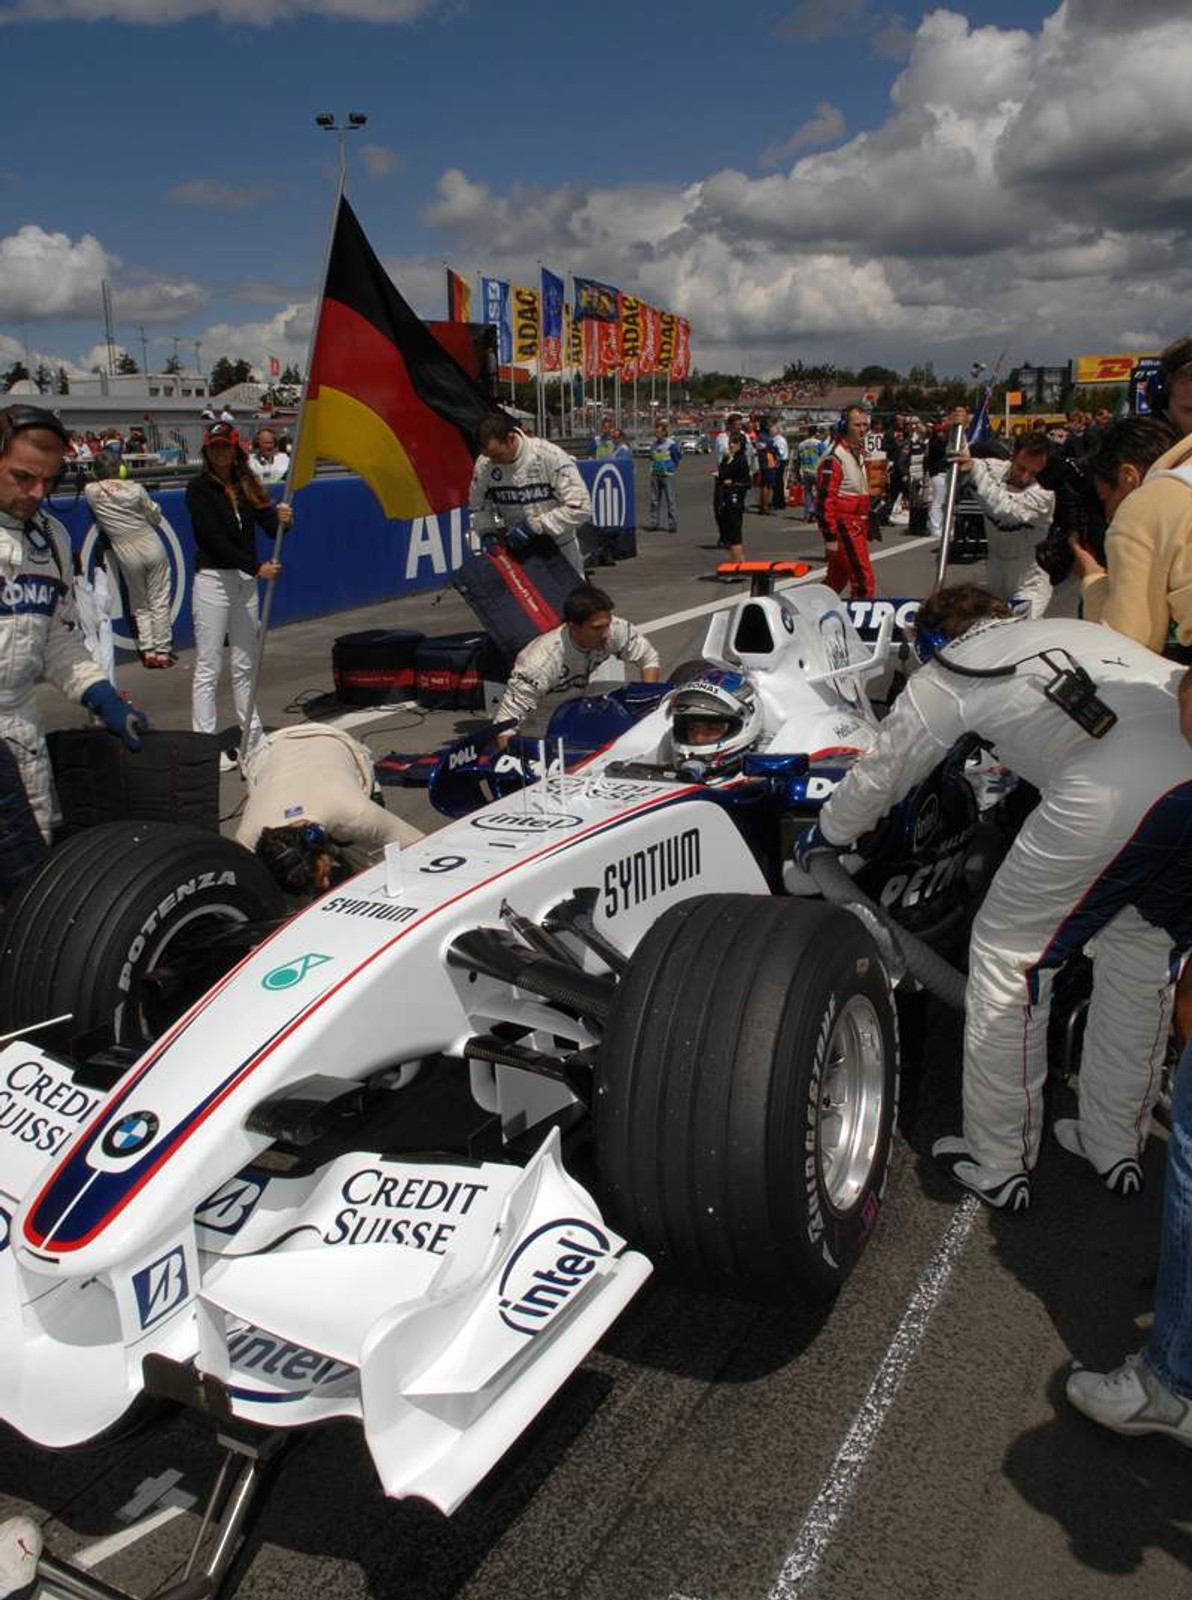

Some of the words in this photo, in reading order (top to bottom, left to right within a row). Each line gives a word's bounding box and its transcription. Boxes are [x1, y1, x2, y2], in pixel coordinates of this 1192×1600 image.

[515, 288, 538, 356] ADAC
[622, 295, 640, 358] ADAC
[419, 855, 468, 874] 9
[603, 827, 701, 919] SYNTIUM
[117, 870, 238, 992] POTENZA
[321, 897, 419, 924] SYNTIUM
[6, 1061, 98, 1124] CREDI
[341, 1168, 488, 1216] CREDIT
[323, 1207, 456, 1256] SUISSE
[499, 1236, 598, 1318] intel
